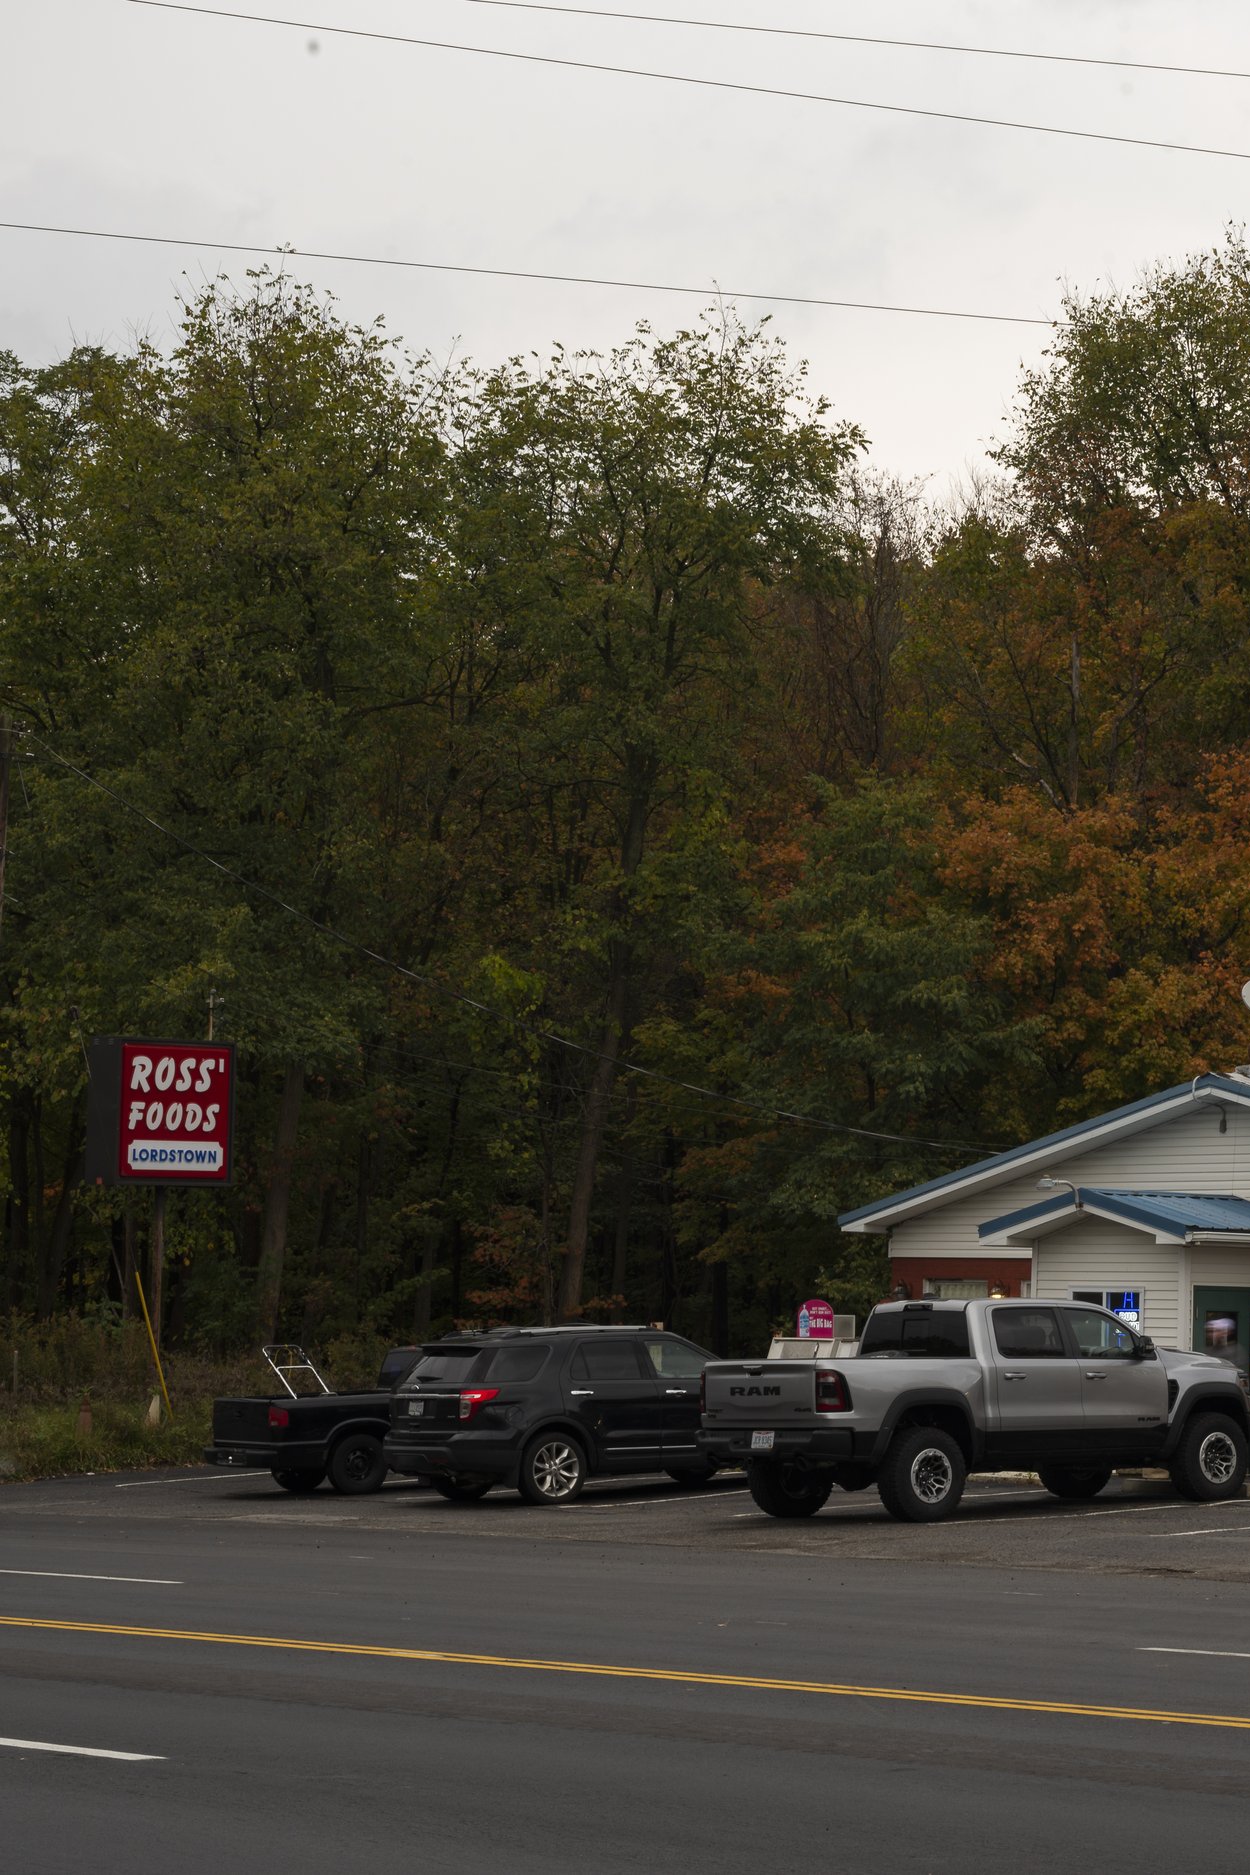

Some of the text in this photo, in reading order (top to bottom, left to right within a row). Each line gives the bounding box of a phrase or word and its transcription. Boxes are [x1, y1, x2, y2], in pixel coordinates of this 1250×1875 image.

[130, 1055, 225, 1093] ROSS'
[128, 1101, 220, 1132] FOODS
[132, 1148, 217, 1164] LORDSTOWN
[824, 1319, 832, 1328] BAG
[730, 1386, 780, 1396] RAM
